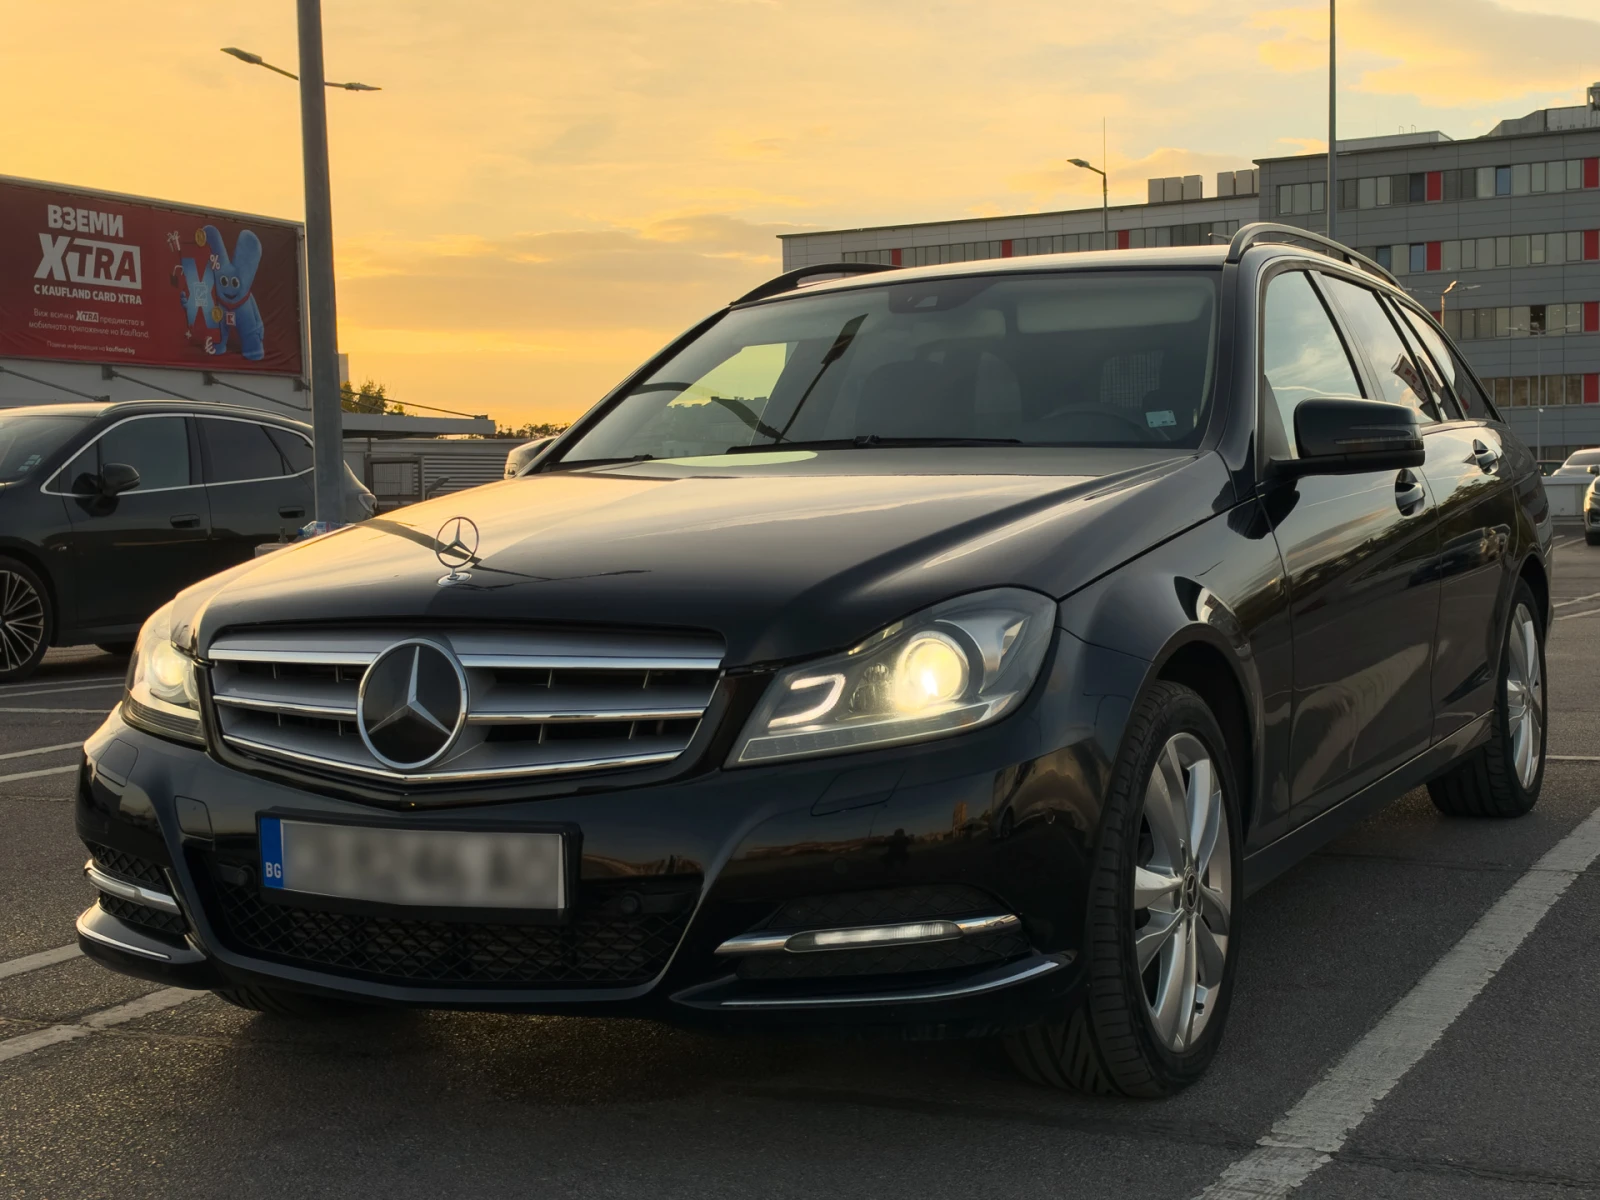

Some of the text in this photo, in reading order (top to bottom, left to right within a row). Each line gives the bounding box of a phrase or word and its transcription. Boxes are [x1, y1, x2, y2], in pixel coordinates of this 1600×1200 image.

[47, 204, 124, 238] ВЗЕМИ
[33, 232, 142, 289] XTRA
[42, 285, 91, 299] KAUFLAND
[92, 290, 116, 302] CARD
[118, 293, 142, 305] XTRA
[33, 308, 48, 317] Виж
[50, 312, 74, 320] всички
[76, 310, 99, 322] XTRA
[106, 345, 135, 355] kaufland.bg
[265, 861, 282, 878] BG
